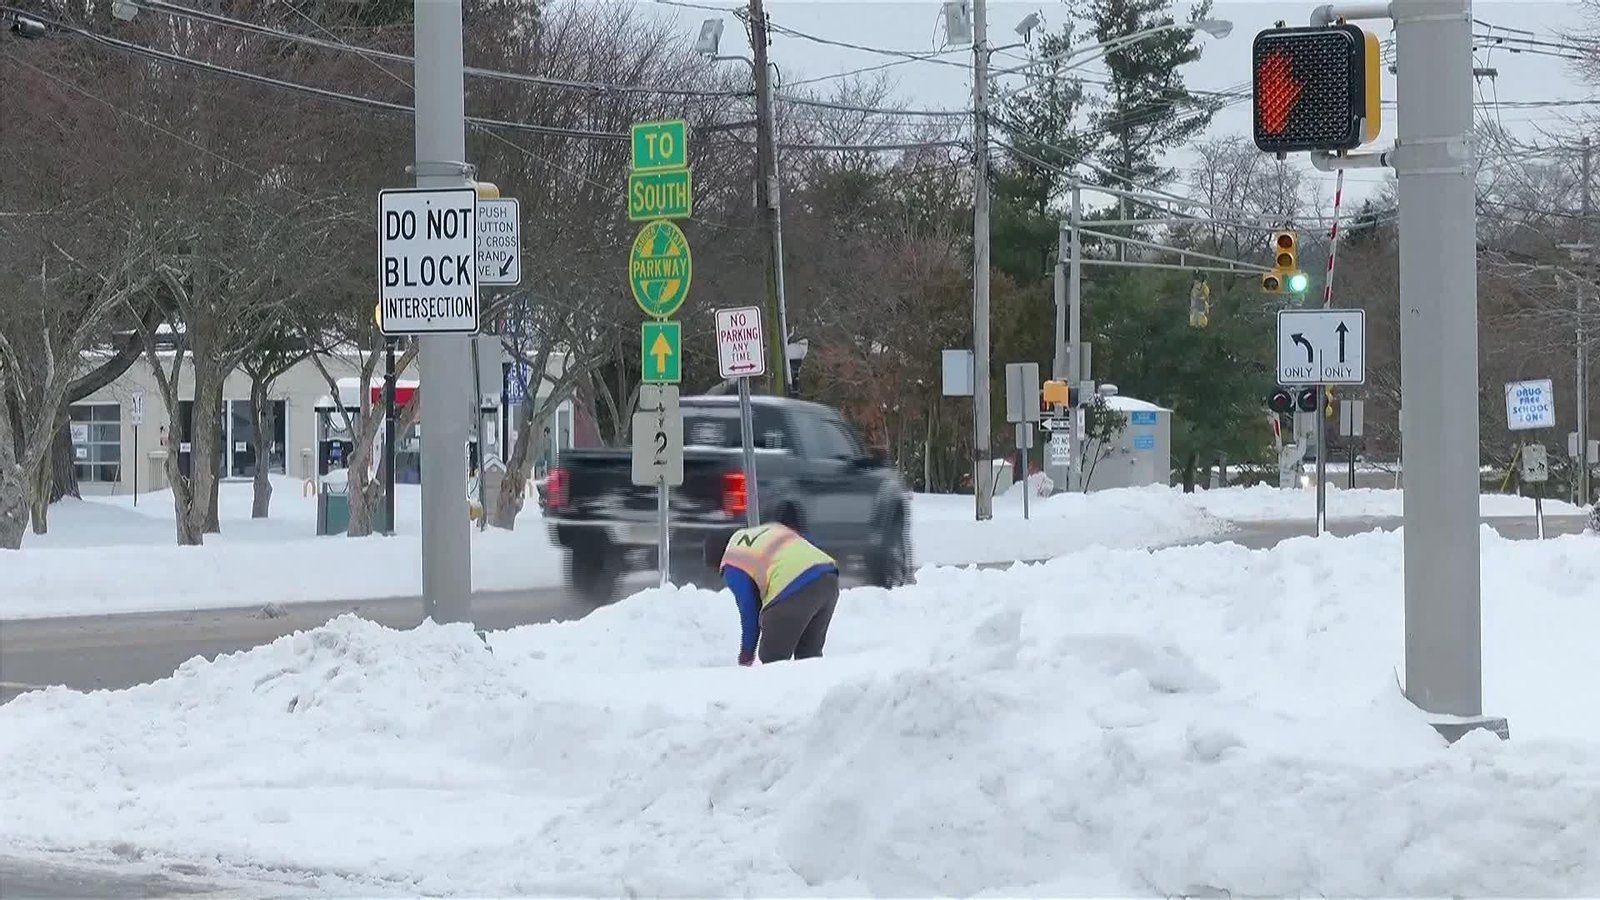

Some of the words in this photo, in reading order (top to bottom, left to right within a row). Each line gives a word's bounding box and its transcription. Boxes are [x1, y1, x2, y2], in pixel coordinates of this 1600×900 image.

[644, 132, 674, 161] TO
[633, 180, 687, 212] SOUTH
[479, 206, 507, 219] PUSH
[386, 210, 417, 241] DO
[427, 208, 472, 240] NOT
[477, 221, 514, 233] UTTON
[486, 235, 517, 248] CROSS
[477, 250, 507, 262] RAND
[385, 255, 472, 288] BLOCK
[477, 265, 496, 276] VE.
[633, 258, 688, 279] PARKWAY
[385, 296, 473, 319] INTERSECTION
[730, 314, 747, 327] NO
[720, 327, 759, 342] PARKING
[732, 342, 749, 351] ANY
[731, 352, 751, 361] TIME
[1284, 367, 1313, 378] ONLY
[1324, 367, 1352, 378] ONLY
[1516, 387, 1542, 397] DRUG
[1512, 404, 1549, 415] SCHOOL
